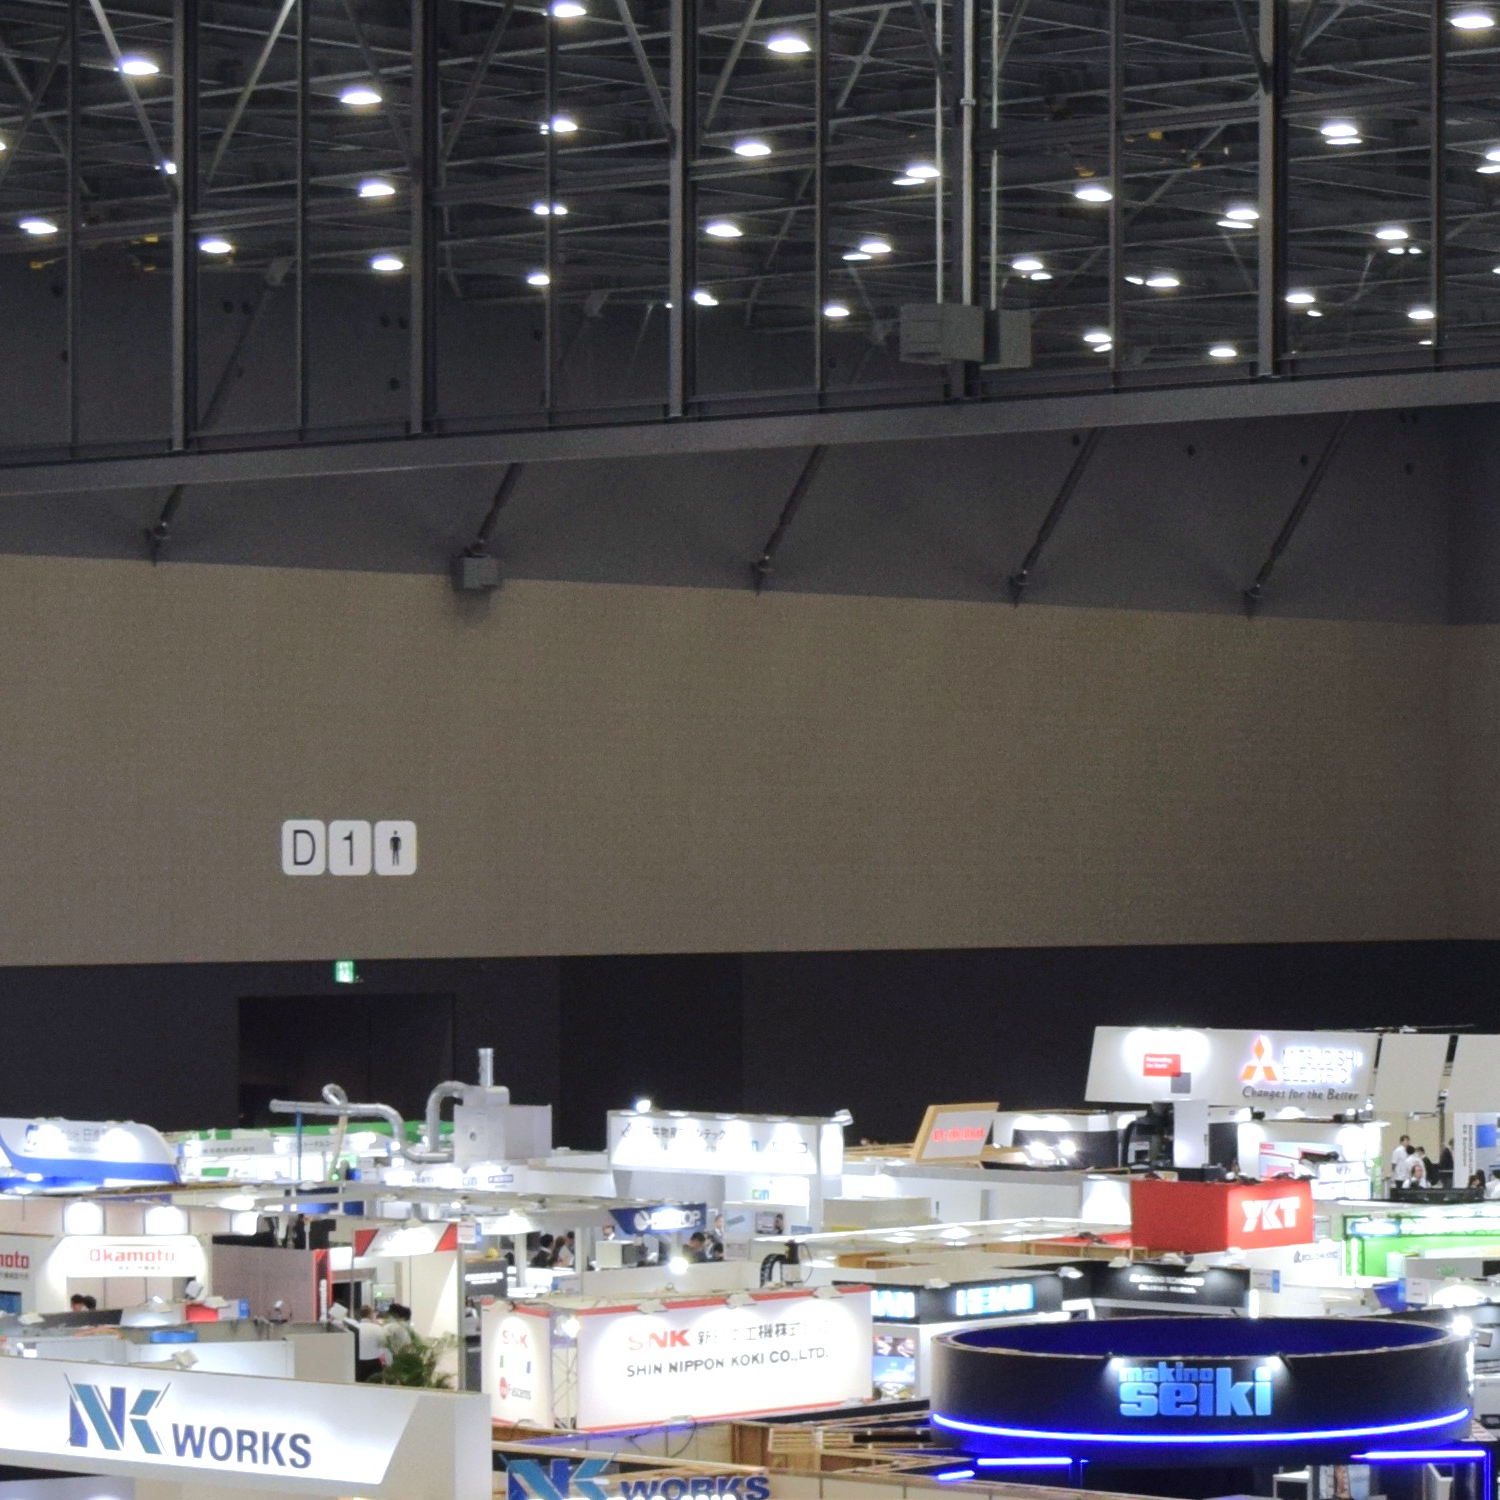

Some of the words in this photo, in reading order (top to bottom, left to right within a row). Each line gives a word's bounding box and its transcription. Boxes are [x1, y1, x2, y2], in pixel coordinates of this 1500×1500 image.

[1242, 1086, 1286, 1100] Changes
[1288, 1089, 1304, 1101] for
[1307, 1089, 1323, 1100] the
[1327, 1088, 1359, 1100] Better
[1241, 1196, 1300, 1233] YKT
[89, 1248, 175, 1262] Okamoto
[627, 1328, 691, 1352] SNK
[626, 1362, 663, 1378] SHIN
[668, 1356, 725, 1374] NIPPON
[731, 1353, 765, 1367] KOKI
[1119, 1361, 1214, 1382] makino
[1119, 1366, 1273, 1417] seiki
[172, 1423, 312, 1469] WORKS
